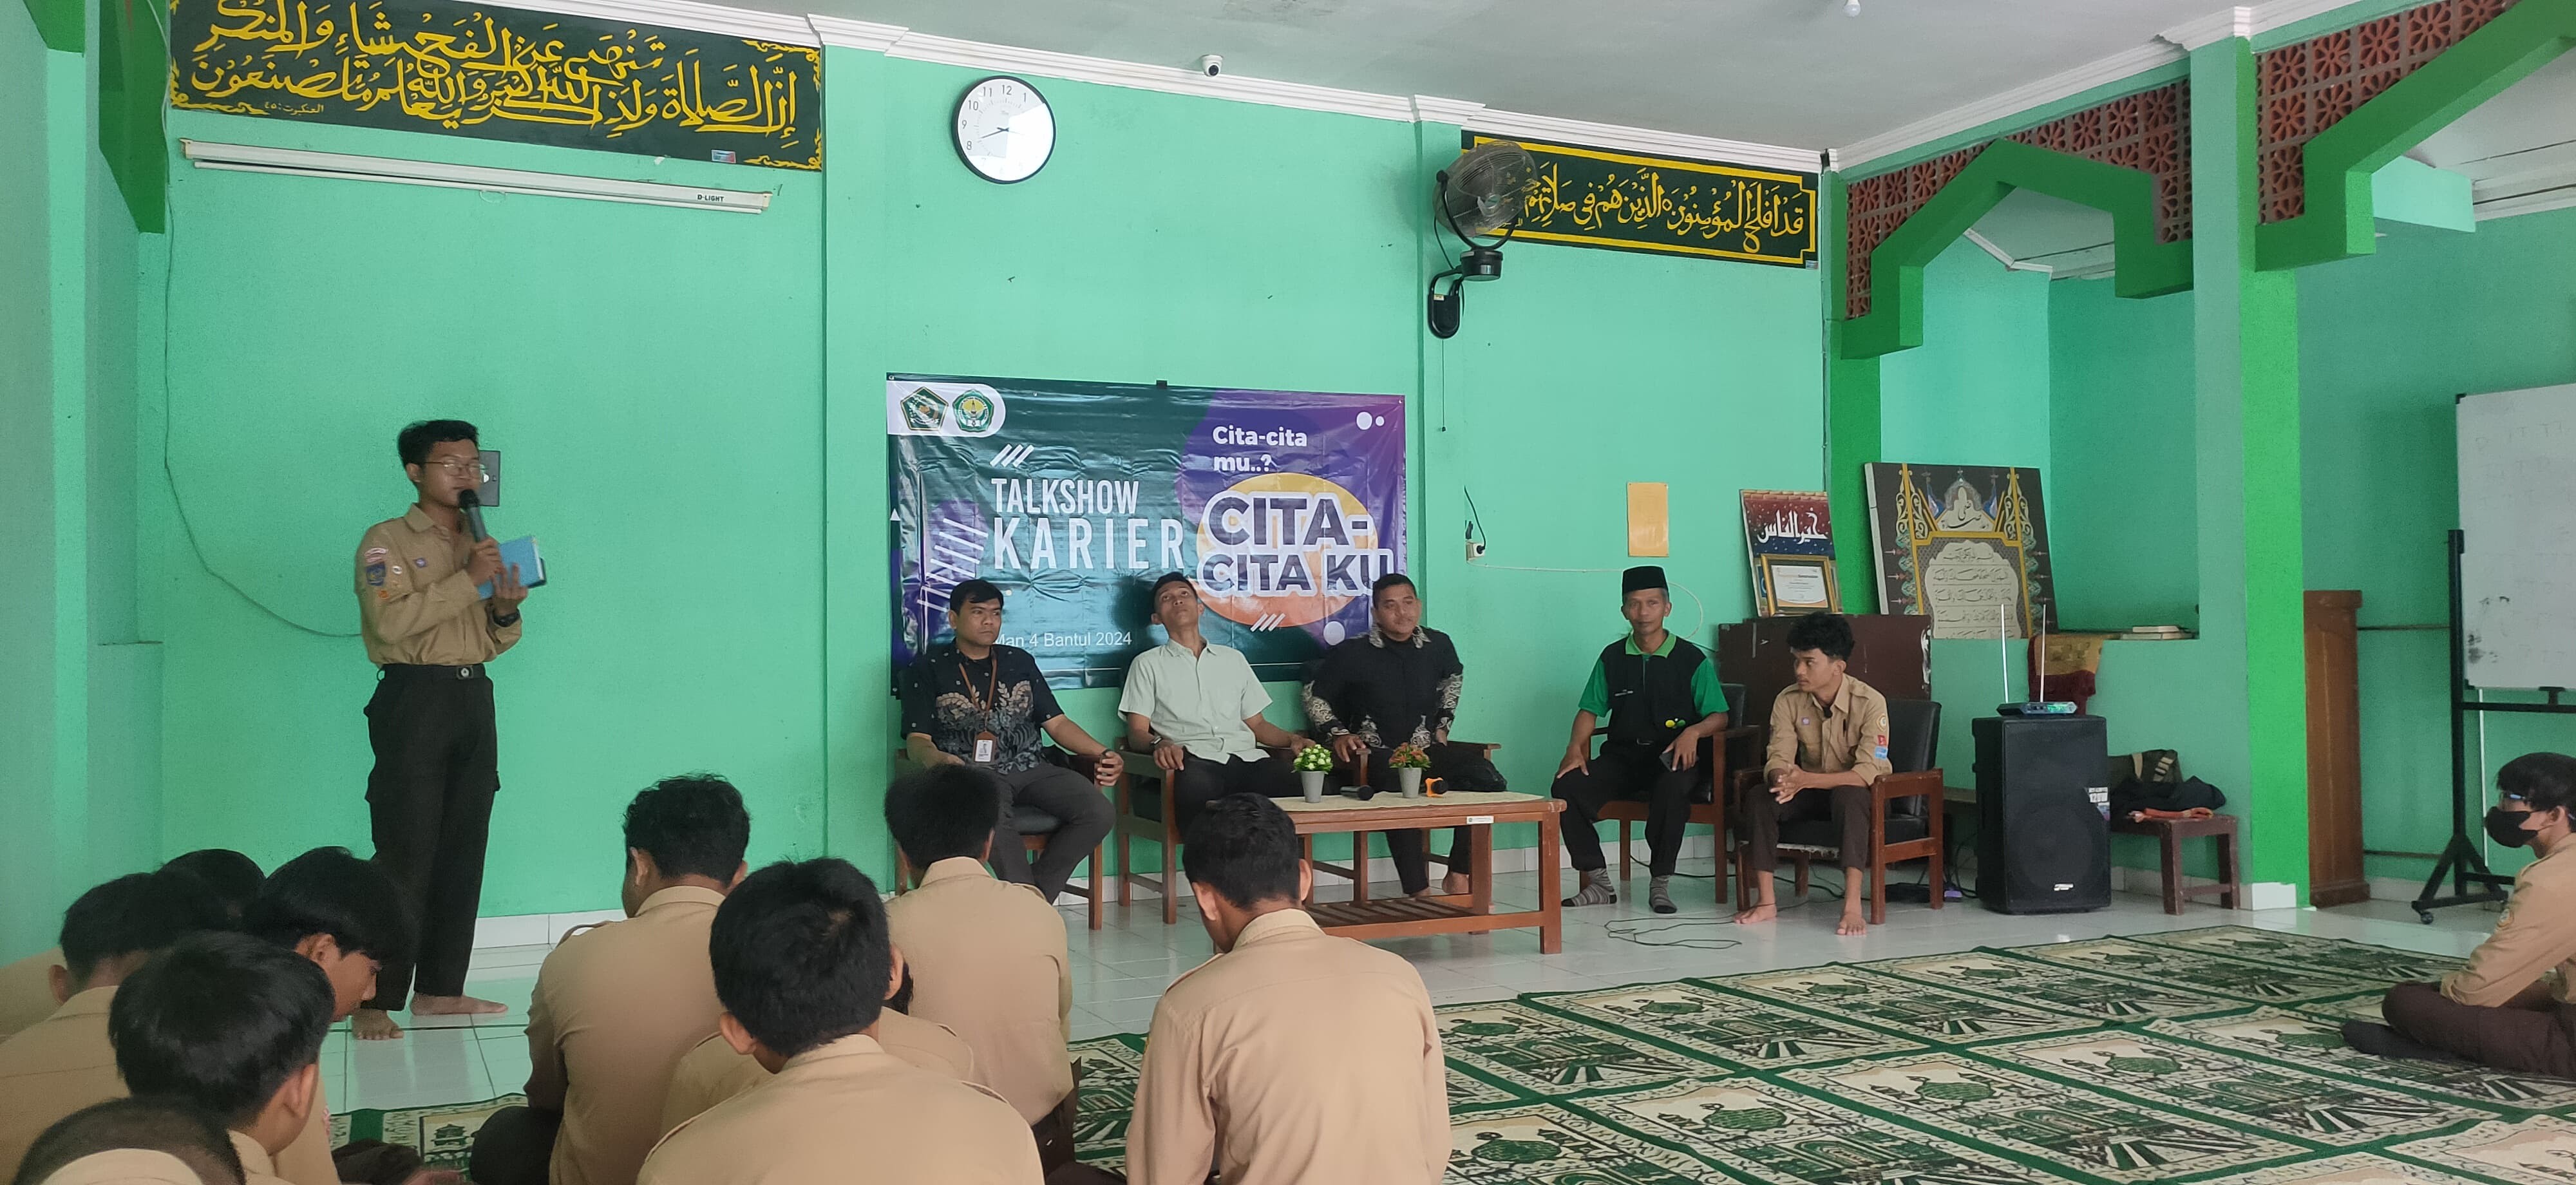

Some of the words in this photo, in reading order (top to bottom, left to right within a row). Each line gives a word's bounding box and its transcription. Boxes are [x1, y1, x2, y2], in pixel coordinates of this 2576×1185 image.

[983, 86, 992, 97] 11
[1001, 84, 1012, 95] 12
[1023, 93, 1027, 102] 1
[969, 100, 979, 111] 10
[961, 120, 967, 129] 9
[966, 140, 972, 150] 8
[697, 194, 724, 202] D-LIGHT
[1213, 424, 1308, 447] Cita-cita
[1213, 454, 1273, 472] mu..?
[991, 478, 1139, 515] TALKSHOW
[1208, 497, 1368, 546] CITA-
[994, 517, 1185, 569] KARIER
[1202, 553, 1312, 592] CITA
[1326, 554, 1388, 591] KU
[1029, 634, 1039, 647] 4
[1043, 632, 1092, 647] Bantul
[1096, 632, 1132, 646] 2024
